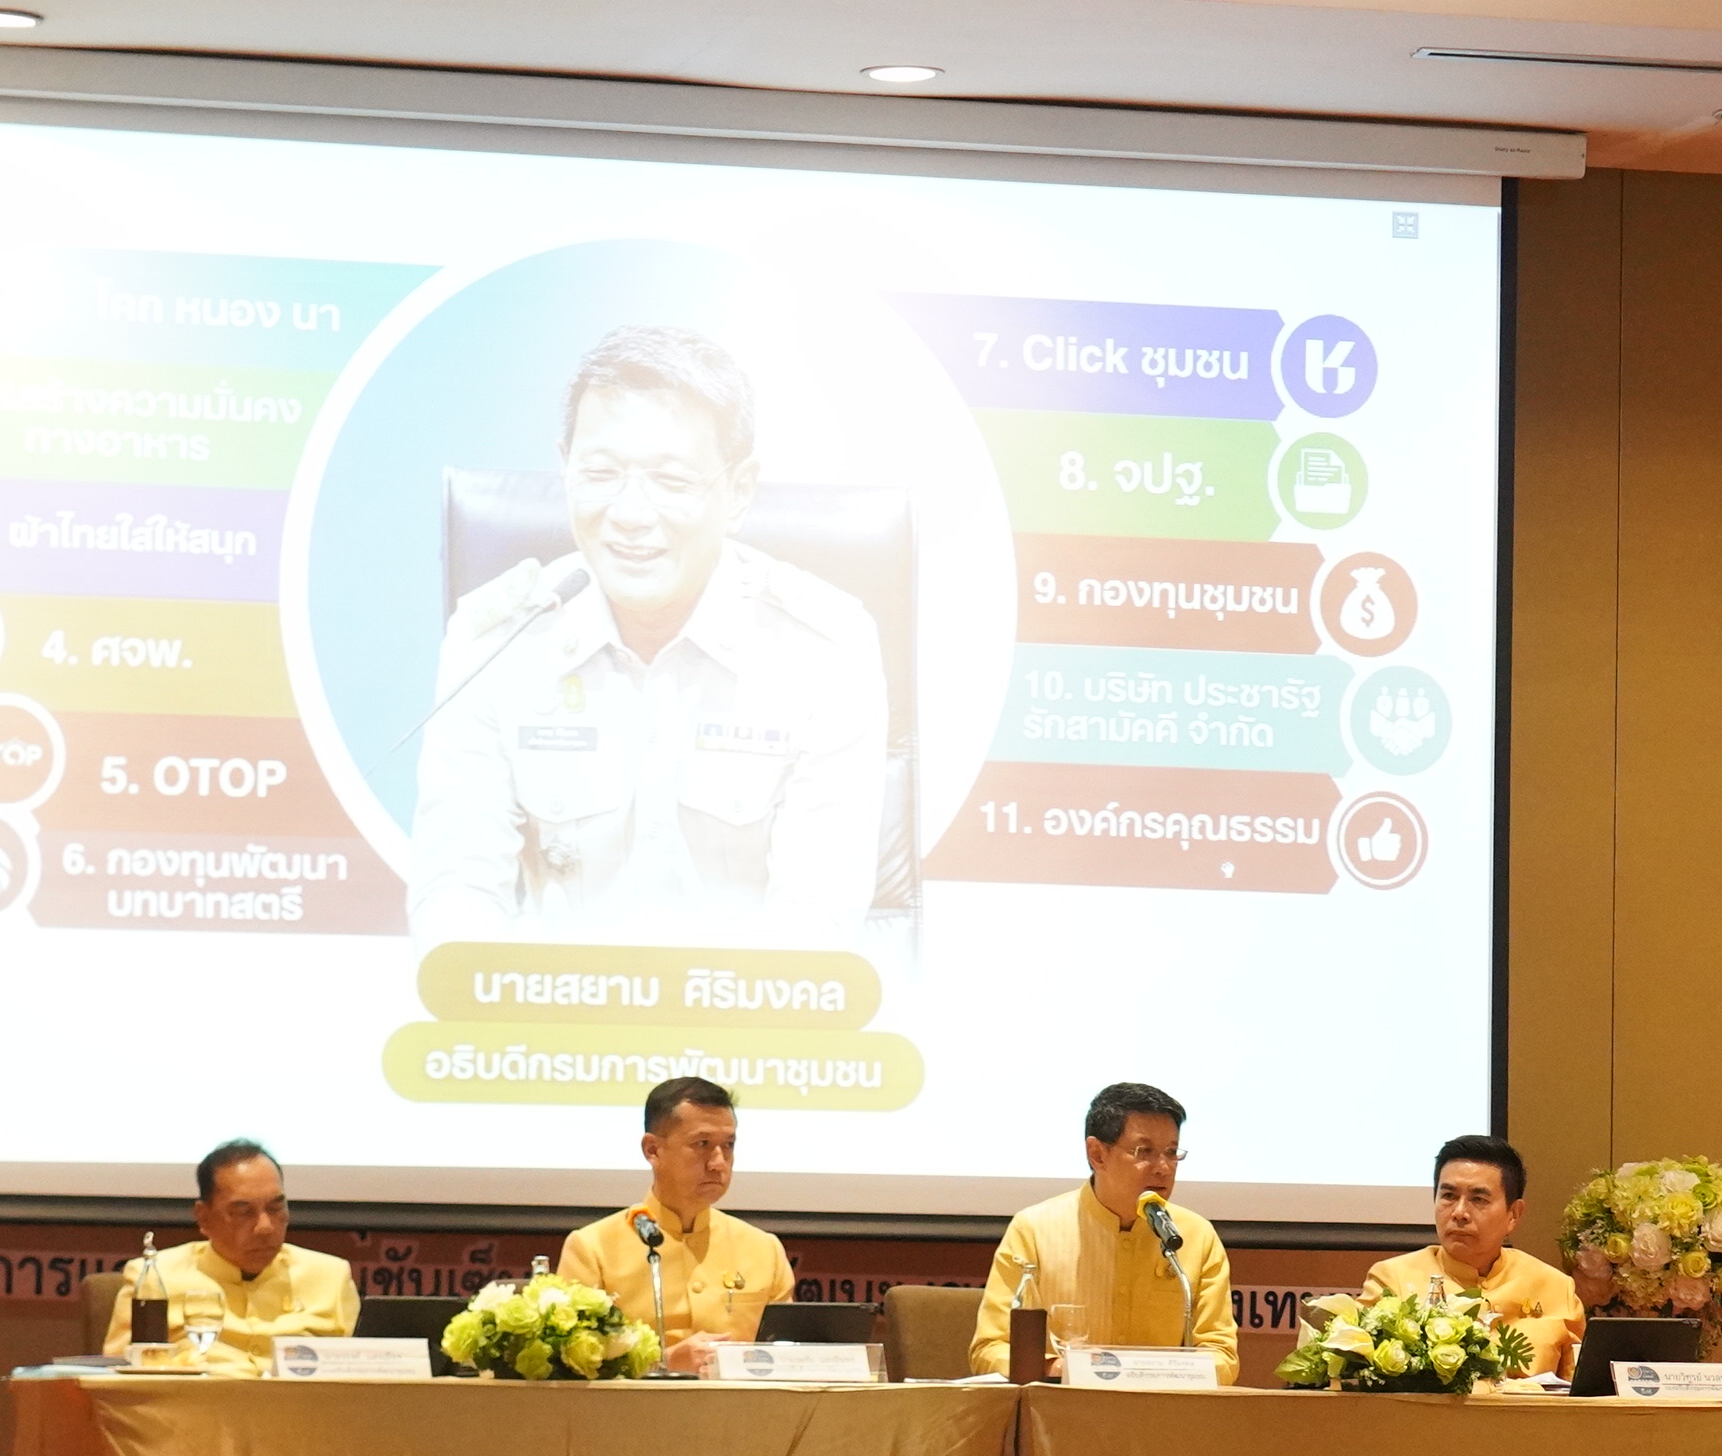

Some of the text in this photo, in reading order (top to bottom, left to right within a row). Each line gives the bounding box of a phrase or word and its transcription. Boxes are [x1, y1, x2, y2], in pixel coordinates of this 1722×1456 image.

[175, 295, 281, 329] หนอง
[291, 301, 340, 332] นา
[972, 331, 1249, 388] 7. Click ชุมชน
[1058, 450, 1215, 506] 8. จปฐ.
[1033, 570, 1298, 621] 9. กองทุนชุมชน
[41, 628, 193, 669] 4. ศจพ.
[1024, 670, 1321, 718] 10. บริษัท ประชารัฐ
[1023, 705, 1273, 748] รักสามัคคี จำกัด
[100, 755, 288, 799] 5. OTOP
[980, 800, 1320, 852] 11. องค์กรคุณธรรม
[62, 842, 348, 888] 6. กองทุนพัฒนา
[107, 884, 304, 922] บทบาทสตรี
[474, 967, 846, 1012] นายสยาม ศิริมงคล
[425, 1042, 882, 1096] อธิบดีกรมการพัฒนาชุมชน
